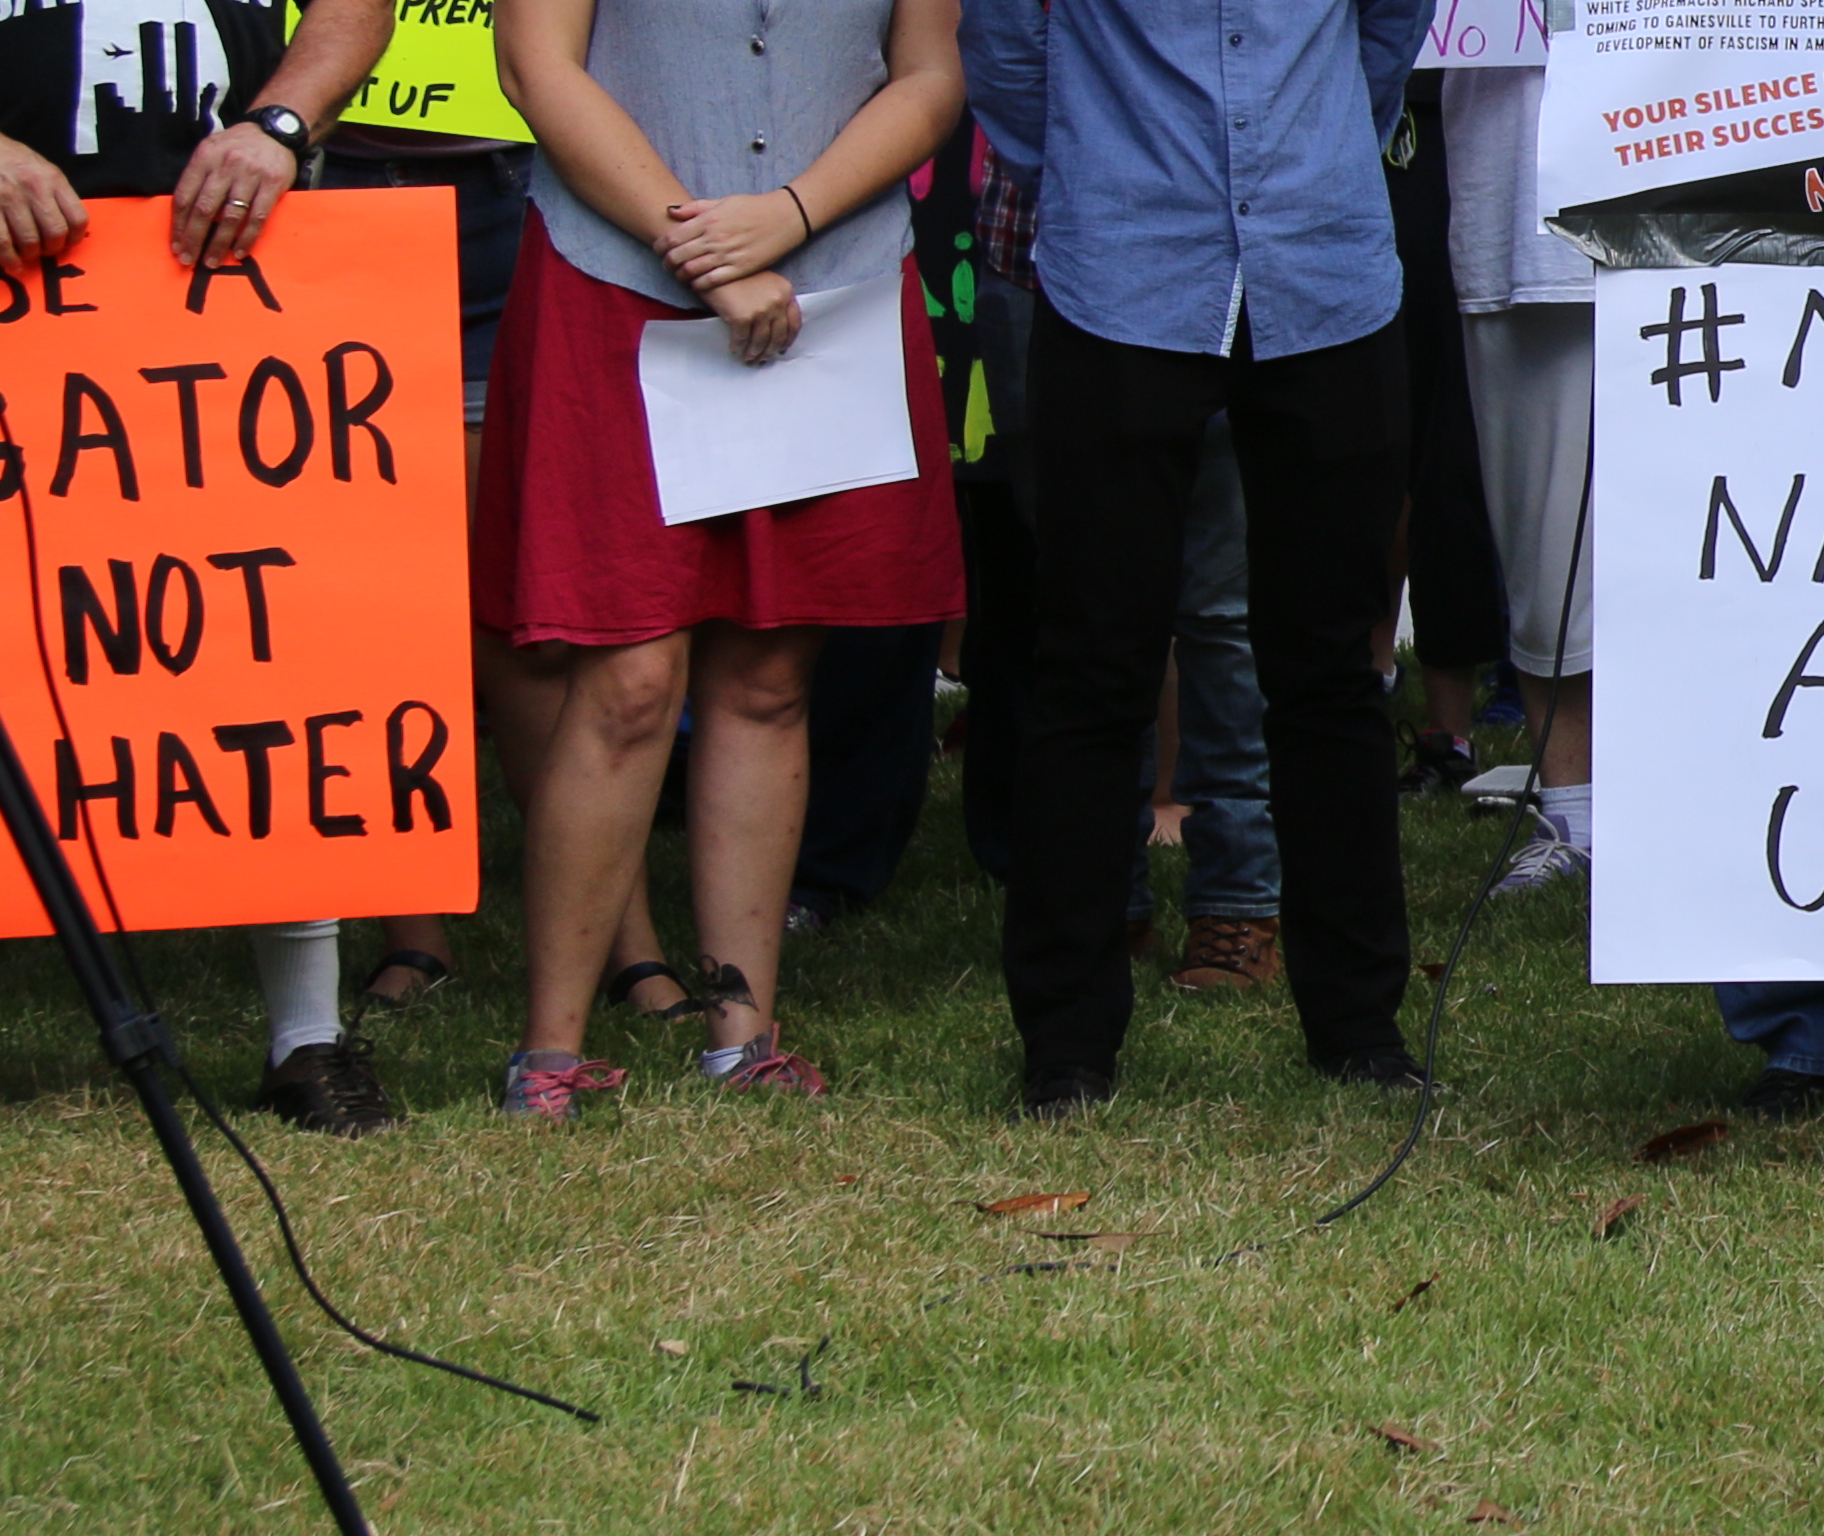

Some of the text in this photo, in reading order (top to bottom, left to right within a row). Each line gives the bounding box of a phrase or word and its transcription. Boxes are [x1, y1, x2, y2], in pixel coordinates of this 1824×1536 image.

[1586, 0, 1631, 16] WHITE
[1586, 19, 1637, 37] COMING
[1643, 15, 1660, 30] TO
[1665, 14, 1753, 29] GAINESVILLE
[1760, 15, 1777, 30] TO
[1596, 35, 1692, 54] DEVELOPMENT
[1698, 35, 1715, 49] OF
[1720, 35, 1779, 51] FASCISM
[1784, 37, 1799, 51] IN
[387, 80, 456, 118] UF
[1602, 98, 1687, 133] YOUR
[1693, 72, 1819, 115] SILENCE
[1613, 130, 1705, 168] THEIR
[56, 546, 298, 686] NOT
[54, 699, 453, 842] HATER
